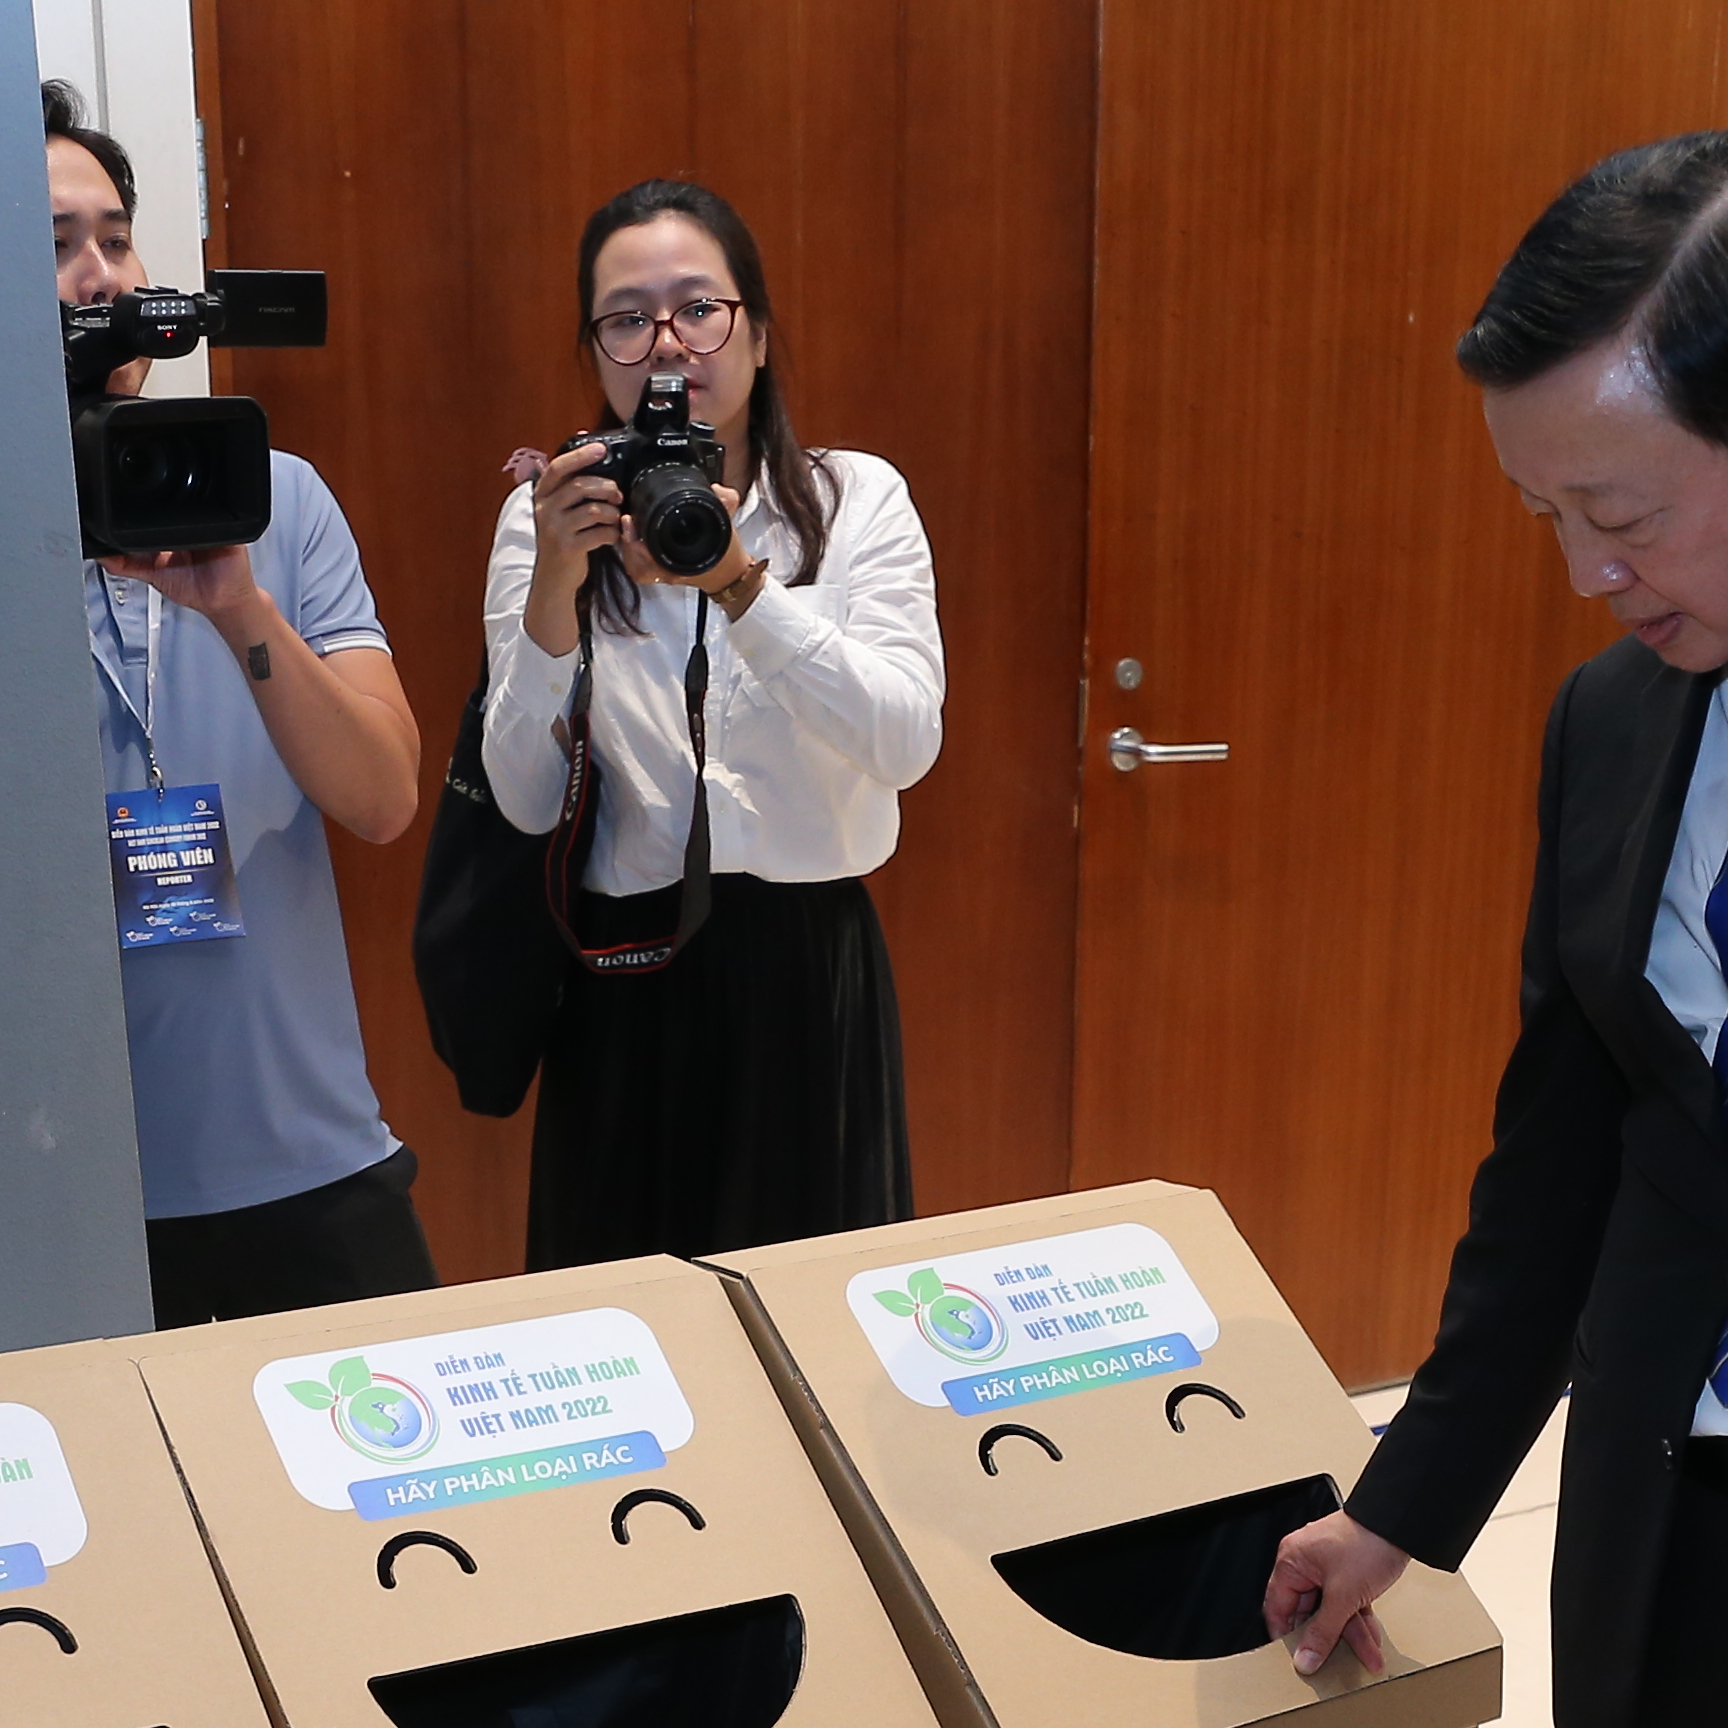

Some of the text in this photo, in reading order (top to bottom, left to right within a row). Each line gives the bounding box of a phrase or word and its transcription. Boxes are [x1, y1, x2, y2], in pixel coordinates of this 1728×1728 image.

[657, 438, 688, 446] Canon
[565, 740, 584, 821] Canon
[128, 847, 214, 872] PHÓNG VIÊN
[597, 948, 670, 967] Canon
[994, 1267, 1025, 1286] DIỄN
[1007, 1266, 1165, 1314] KINH TẾ TUẦN HOÀN
[1023, 1302, 1149, 1340] VIỆT NAM 2022
[435, 1353, 505, 1376] DIỄN ĐÀN
[446, 1358, 640, 1406] KINH TẾ TUẦN HOÀN
[974, 1345, 1173, 1402] HÃY PHÂN LOẠI RÁC
[460, 1396, 612, 1437] VIỆT NAM 2022
[387, 1444, 633, 1506] HÃY PHÂN LOẠI RÁC
